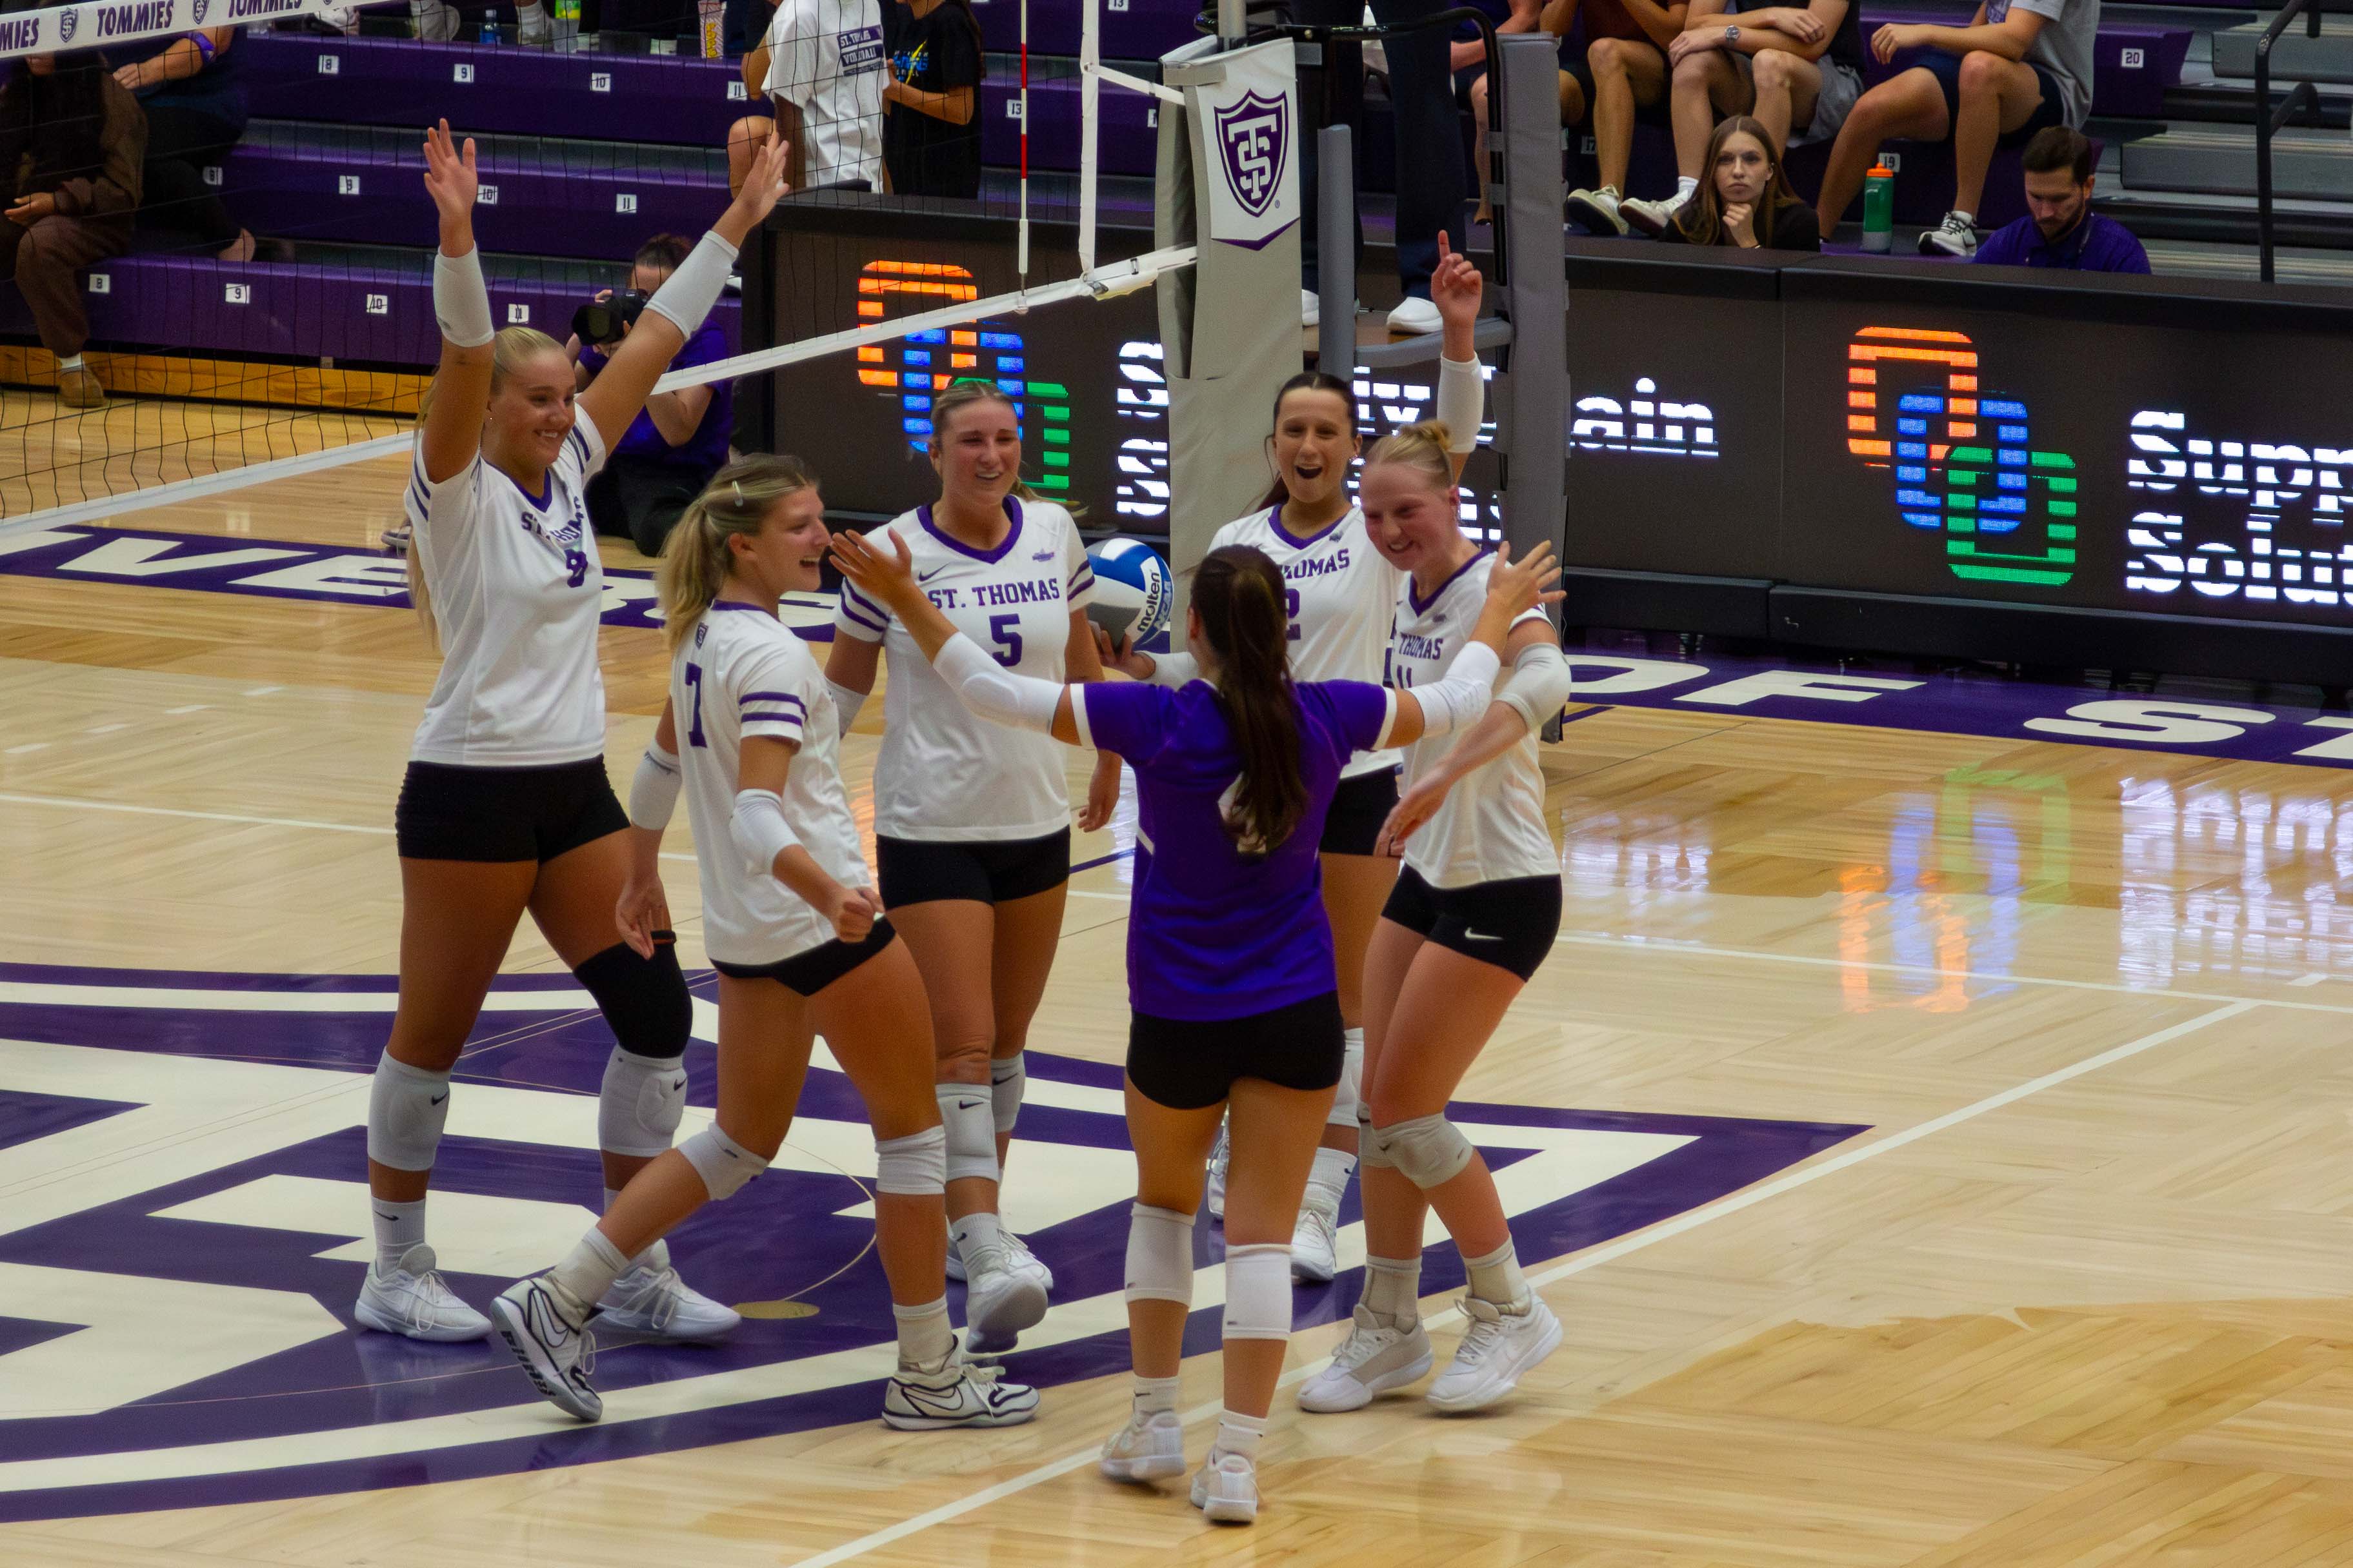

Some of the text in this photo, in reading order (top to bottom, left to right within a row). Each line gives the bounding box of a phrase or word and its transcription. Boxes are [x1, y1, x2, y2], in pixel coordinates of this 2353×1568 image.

[97, 0, 174, 36] TOMMIES
[2125, 52, 2140, 64] 20
[461, 67, 468, 79] 9
[596, 77, 606, 88] 10
[734, 84, 741, 97] 11
[1011, 103, 1022, 115] 13
[1884, 156, 1896, 168] 19
[483, 188, 493, 201] 10
[622, 197, 630, 209] 11
[96, 278, 103, 289] 8
[235, 288, 241, 299] 9
[371, 298, 383, 310] 10
[515, 308, 523, 319] 11
[928, 578, 1060, 609] ST. THOMAS
[1137, 572, 1160, 632] molten
[990, 613, 1022, 667] 5
[1399, 632, 1443, 660] THOMAS
[685, 662, 708, 748] 7
